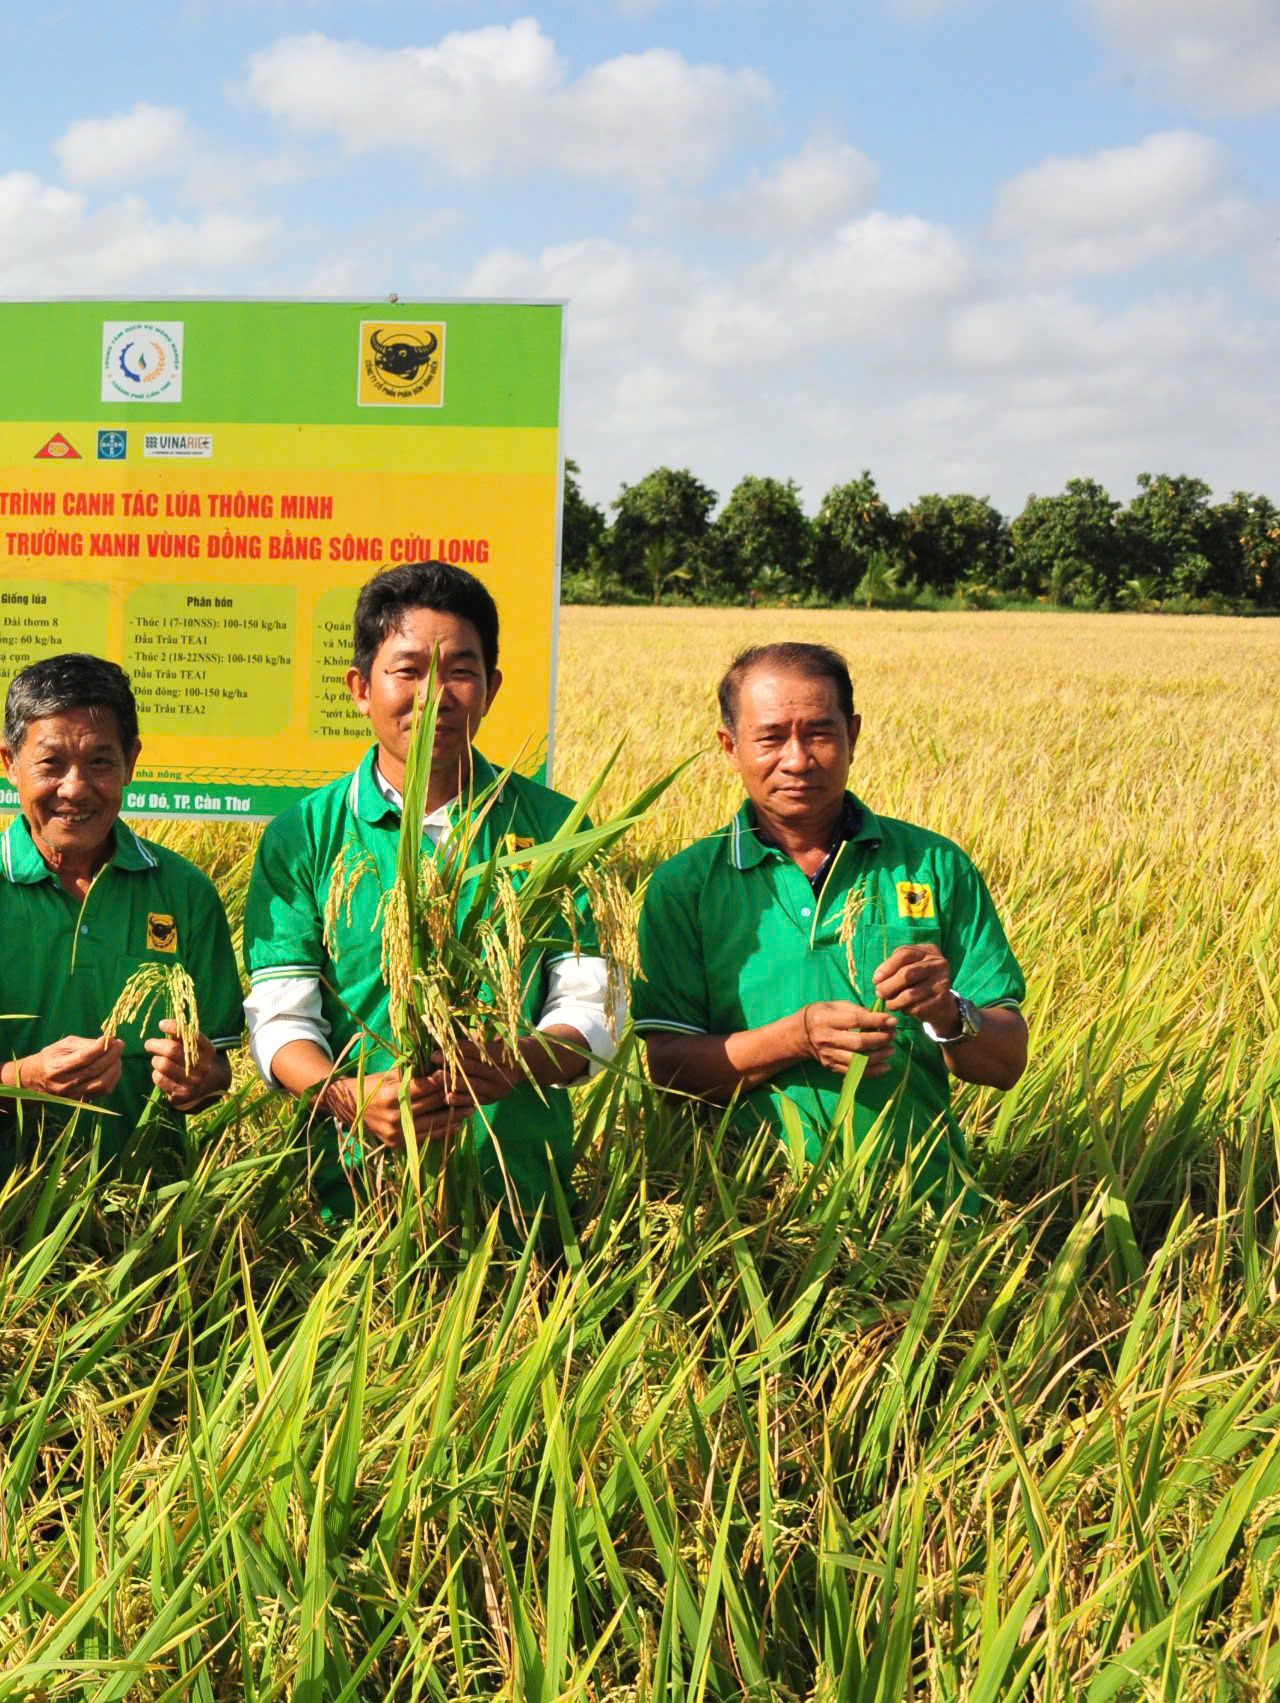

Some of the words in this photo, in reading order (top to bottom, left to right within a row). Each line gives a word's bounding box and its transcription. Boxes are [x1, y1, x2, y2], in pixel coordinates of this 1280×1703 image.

[63, 492, 114, 517] CANH
[122, 489, 158, 517] TÁC
[166, 490, 200, 518] LÚA
[208, 490, 273, 519] THÔNG
[280, 495, 333, 520] MINH
[6, 526, 83, 557] TRƯỞNG
[90, 533, 140, 557] XANH
[147, 529, 200, 558] VÙNG
[207, 527, 261, 559] ĐỒNG
[268, 528, 321, 560] BẰNG
[329, 532, 382, 561] SÔNG
[390, 531, 431, 562] CỬU
[438, 538, 489, 564] LONG
[2, 592, 28, 605] Giống
[32, 593, 47, 604] lúa
[187, 595, 212, 608] Phân
[214, 596, 232, 608] bón
[24, 618, 50, 627] thơm
[52, 617, 58, 627] 8
[136, 617, 159, 627] Thúc
[162, 617, 166, 627] 1
[224, 618, 258, 629] 100-150
[261, 619, 287, 631] kg/ha
[20, 635, 32, 644] 60
[35, 634, 62, 646] kg/ha
[135, 651, 158, 662] Thúc
[160, 652, 166, 662] 2
[227, 653, 263, 664] 100-150
[265, 653, 291, 666] kg/ha
[184, 686, 220, 697] 100-150
[222, 687, 248, 700] kg/ha
[339, 692, 352, 704] dụ
[321, 725, 340, 736] Thu
[344, 726, 372, 739] hoạch
[136, 768, 154, 778] nhà
[158, 769, 182, 780] nông
[128, 792, 146, 808] Cờ
[149, 791, 170, 810] Đỏ,
[174, 794, 191, 810] TP.
[194, 792, 221, 810] Cần
[225, 796, 251, 812] Thơ
